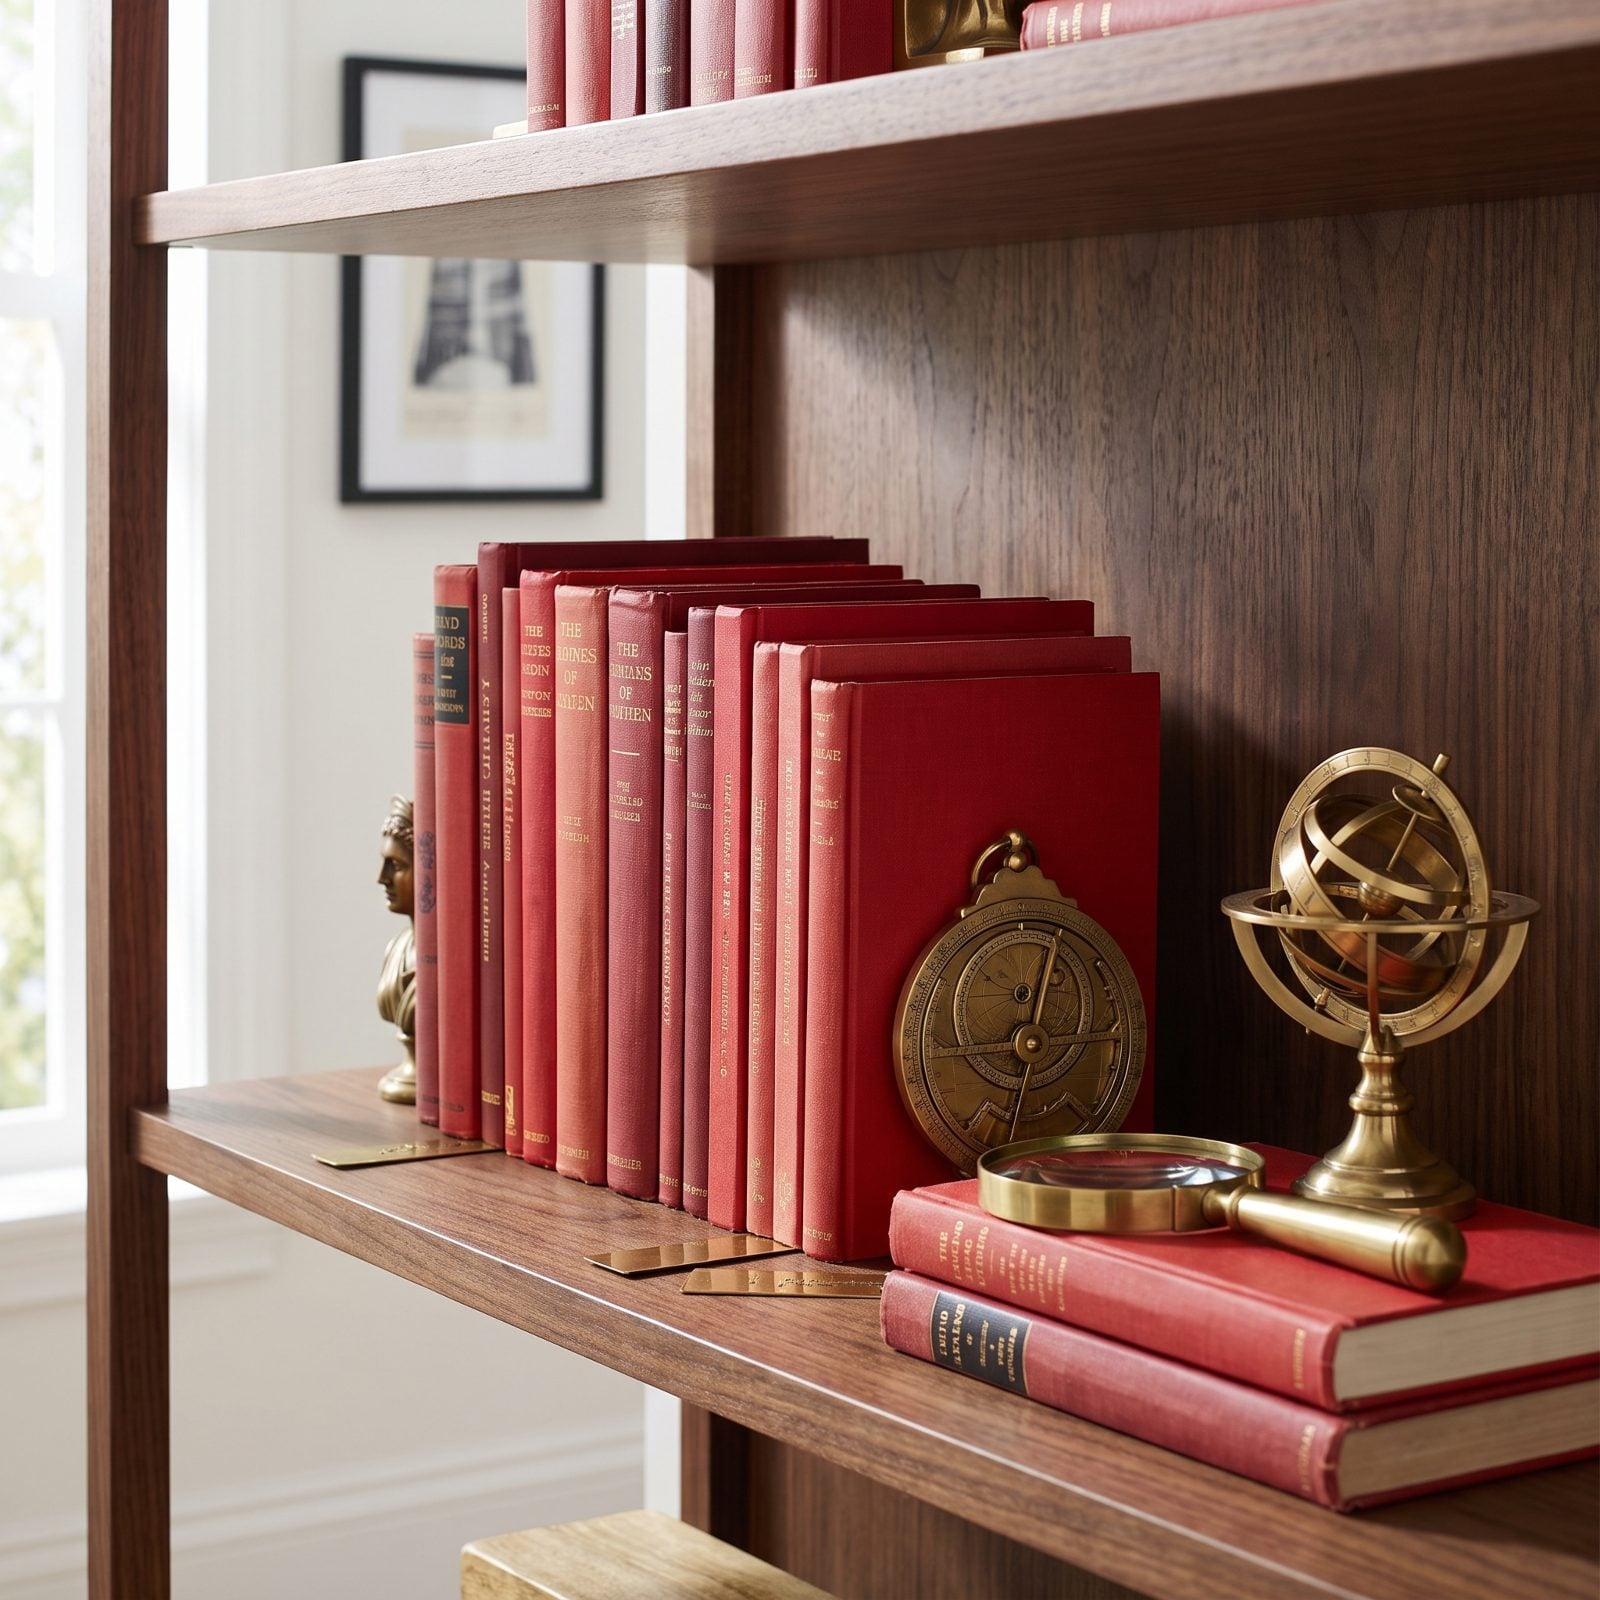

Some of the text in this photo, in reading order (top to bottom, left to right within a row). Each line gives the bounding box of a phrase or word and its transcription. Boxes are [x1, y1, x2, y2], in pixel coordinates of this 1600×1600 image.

[524, 625, 543, 637] THE
[561, 622, 581, 638] THE
[617, 642, 639, 657] THE
[564, 670, 577, 685] OF
[620, 685, 633, 700] OF
